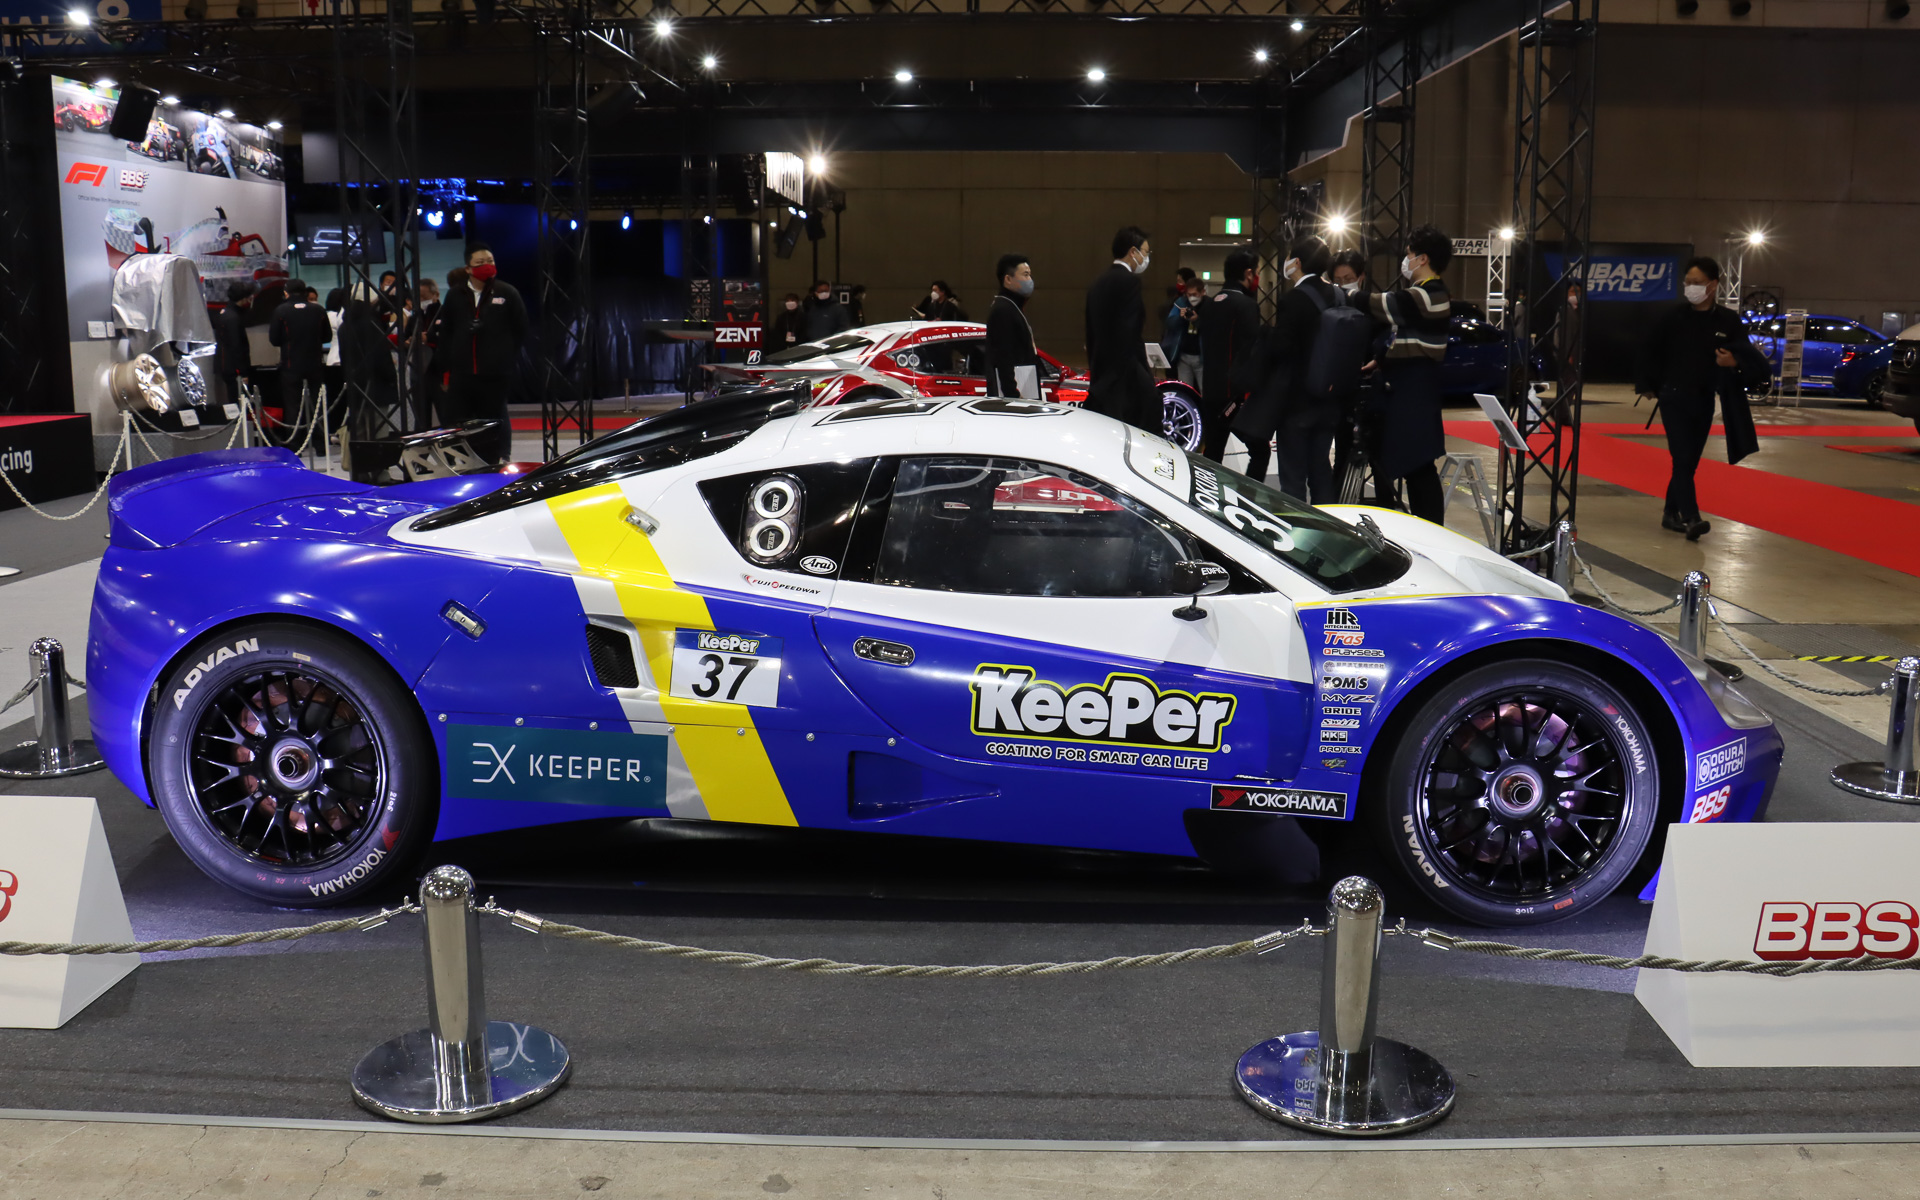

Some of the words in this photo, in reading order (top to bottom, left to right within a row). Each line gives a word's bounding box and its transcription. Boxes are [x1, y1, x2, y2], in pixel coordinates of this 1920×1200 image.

[120, 169, 145, 188] BBS
[1586, 279, 1645, 292] STYLE
[715, 327, 761, 342] ZENT
[0, 447, 33, 473] cing
[1194, 466, 1220, 512] OKURA
[1223, 485, 1295, 552] 37
[803, 558, 833, 570] Arai
[698, 632, 759, 654] KeePer
[1324, 631, 1365, 645] Tras
[173, 637, 260, 711] ADVAN
[692, 653, 759, 700] 37
[1323, 676, 1368, 689] TOM'S
[970, 664, 1236, 751] KeePer
[1323, 707, 1361, 715] BRIDE
[1322, 731, 1347, 741] HKS
[1615, 715, 1647, 775] YOKOHAMA
[986, 742, 1052, 759] COATING
[1056, 749, 1086, 762] FOR
[1089, 751, 1138, 766] SMART
[1142, 754, 1170, 768] CAR
[1174, 757, 1209, 771] LIFE
[1319, 746, 1362, 754] PROTEX
[1711, 743, 1744, 767] OGURA
[529, 754, 640, 782] KEEPER
[1709, 756, 1744, 781] CLUTCH
[1246, 792, 1338, 812] YOKOHAMA
[1689, 784, 1731, 823] BBS
[1402, 815, 1450, 889] ADVAN
[308, 847, 387, 897] YOKOHAMA
[1753, 901, 1920, 961] BBS
